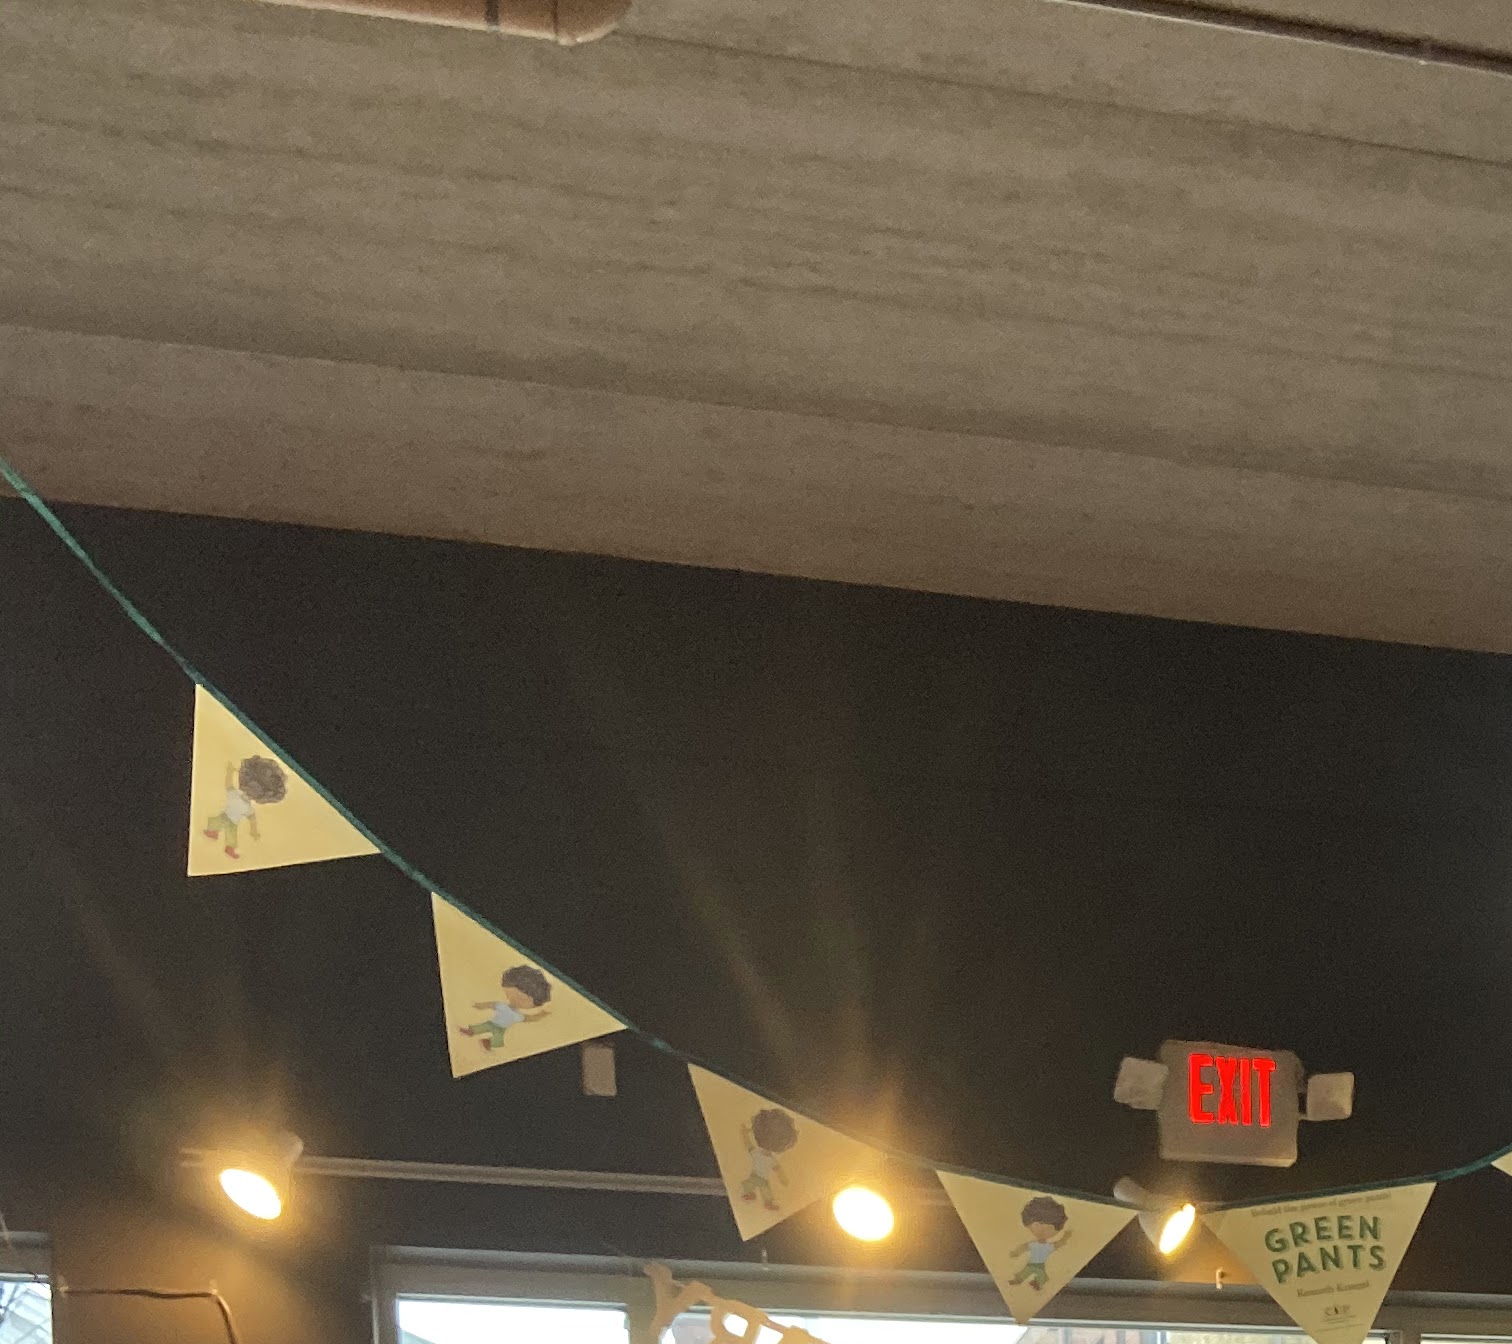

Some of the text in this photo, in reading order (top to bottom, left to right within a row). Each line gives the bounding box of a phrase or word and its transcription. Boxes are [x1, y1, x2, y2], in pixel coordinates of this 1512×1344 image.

[1188, 1053, 1276, 1127] EXIT
[1264, 1215, 1382, 1253] GREEN
[1272, 1244, 1386, 1284] PANTS
